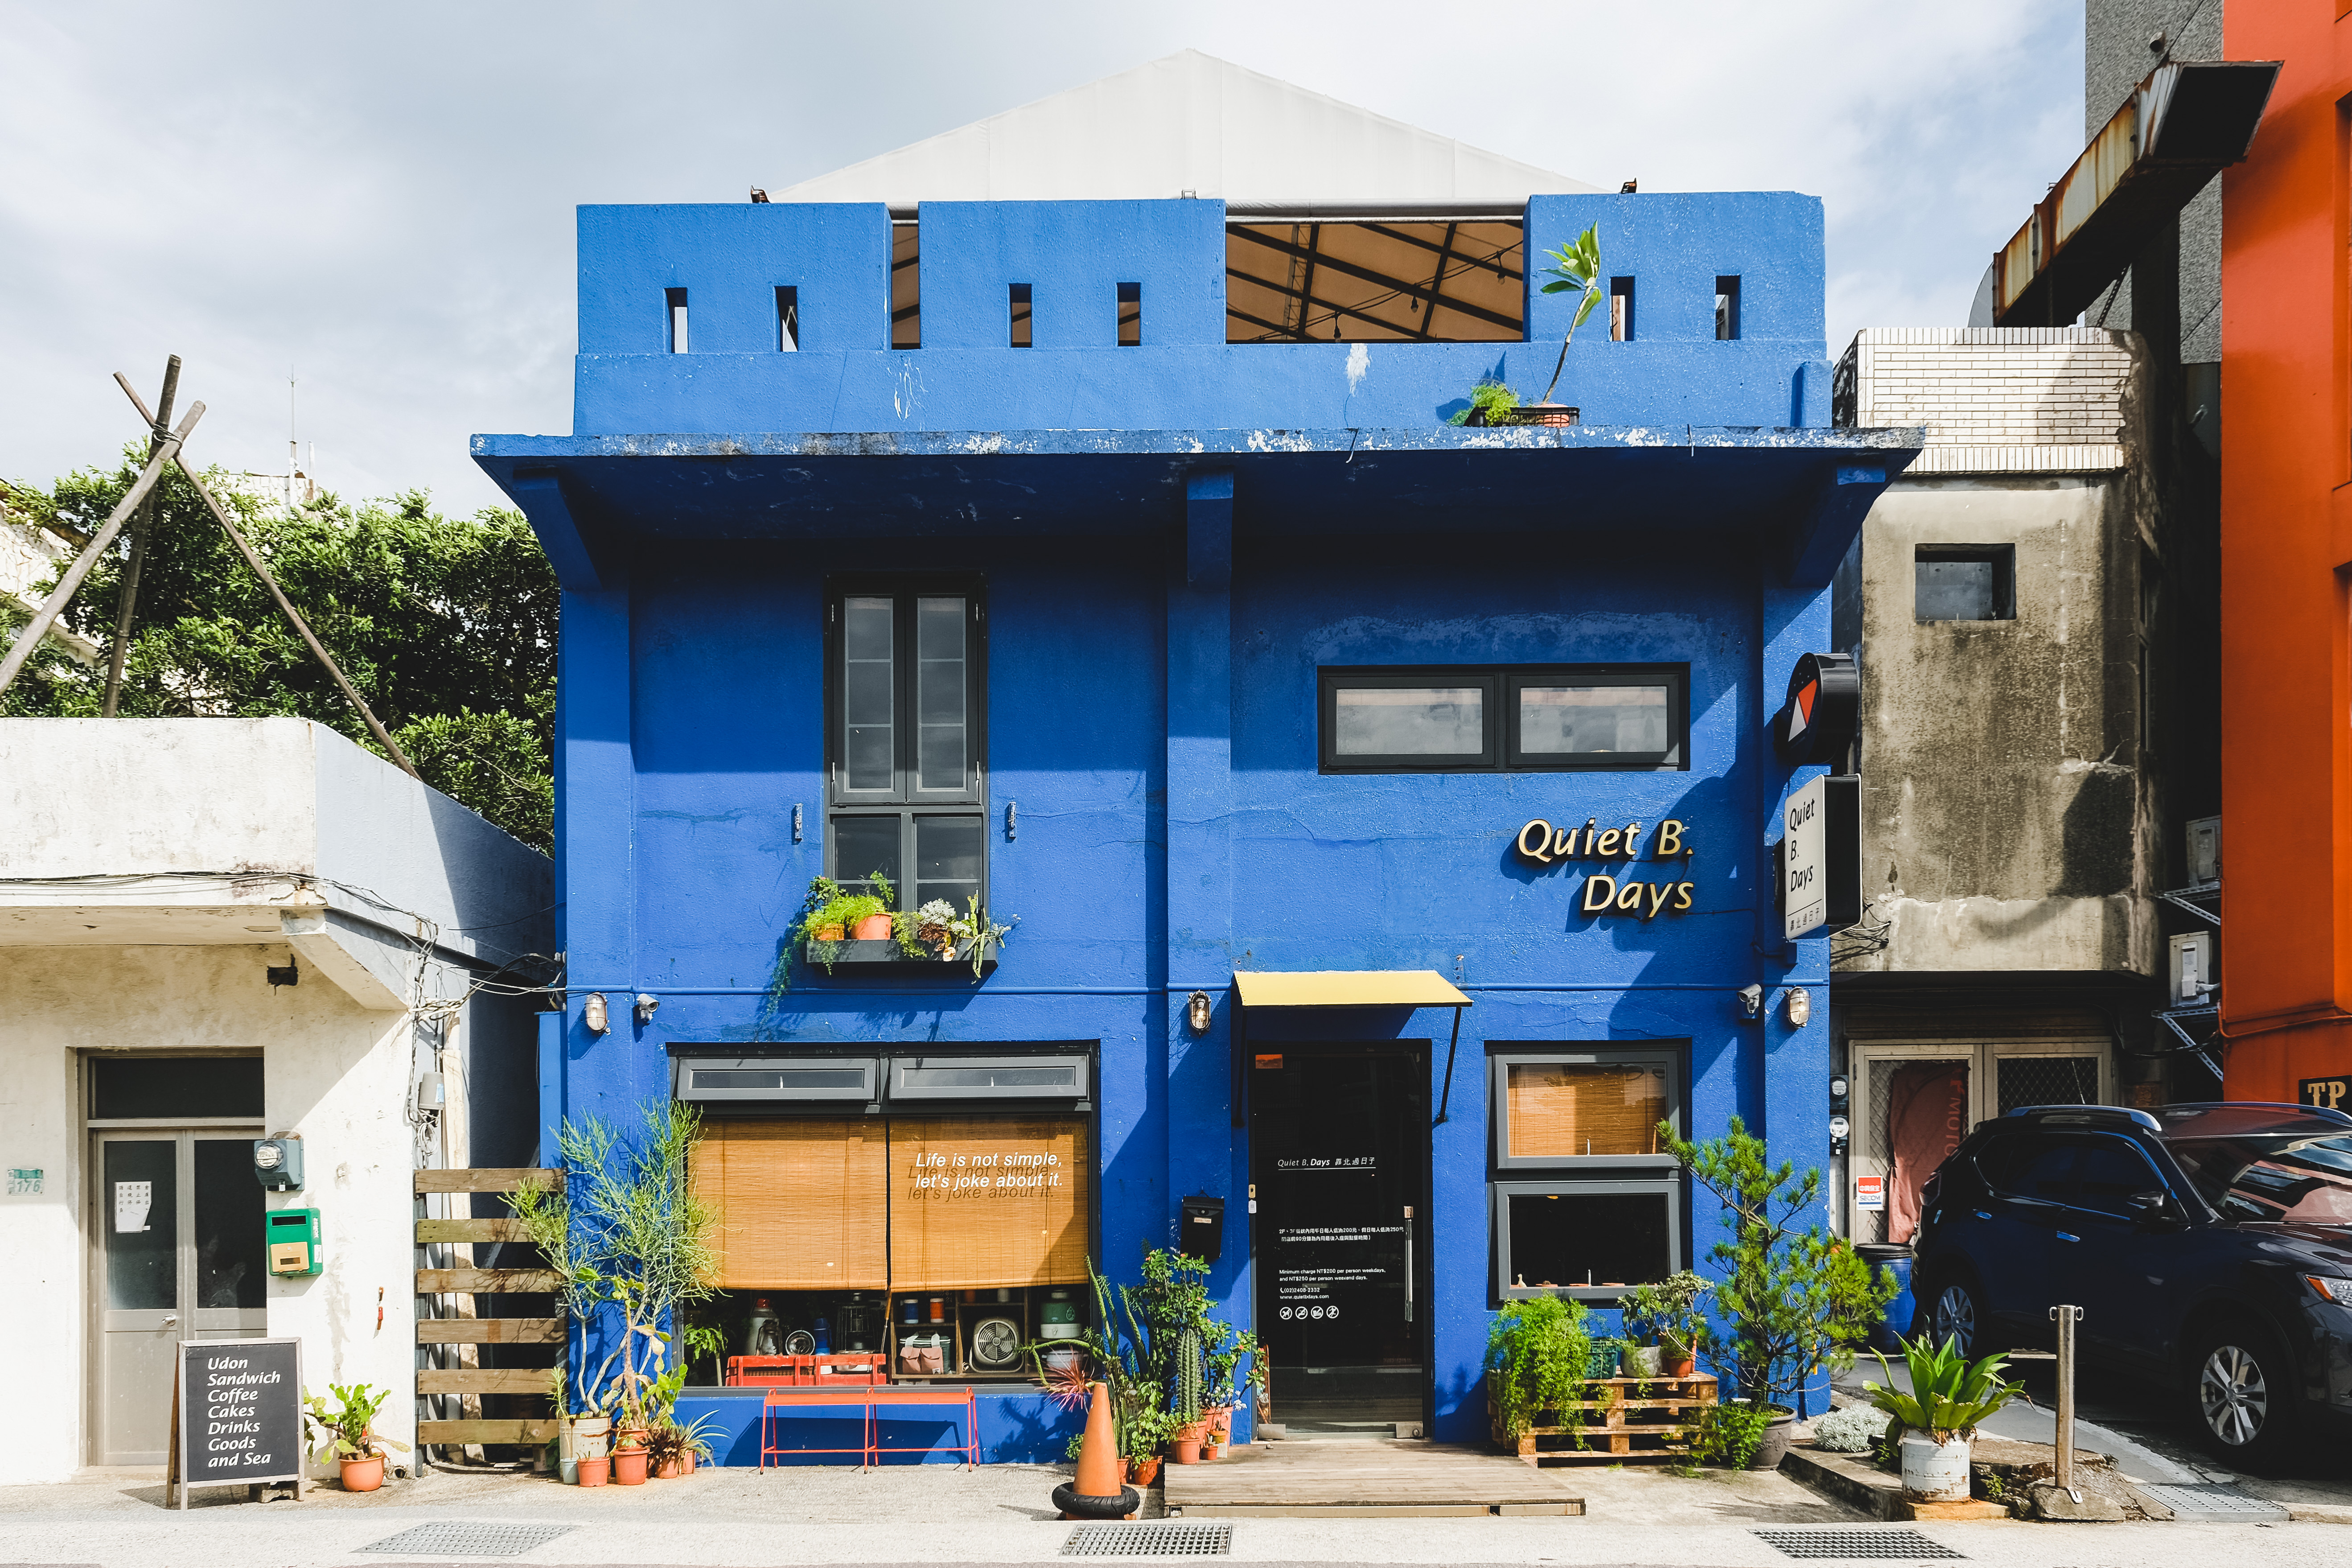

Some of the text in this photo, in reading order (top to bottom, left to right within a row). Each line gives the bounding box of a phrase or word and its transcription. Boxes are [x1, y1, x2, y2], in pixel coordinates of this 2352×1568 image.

[1789, 798, 1815, 832] Quiet
[1518, 818, 1694, 863] Quiet B.
[1790, 840, 1799, 861] B.
[1790, 865, 1813, 892] Days
[1583, 874, 1694, 918] Days
[2307, 1081, 2346, 1108] TP
[916, 1152, 1062, 1169] Life is not simple,
[1278, 1159, 1299, 1168] Quiet
[1310, 1158, 1330, 1167] Days
[17, 1179, 42, 1192] 176
[915, 1173, 1063, 1191] let's joke about it.
[207, 1356, 248, 1370] Udon
[207, 1370, 281, 1386] Sandwich
[208, 1387, 259, 1404] Coffee
[208, 1404, 255, 1419] Cakes
[208, 1420, 260, 1435] Drinks
[208, 1436, 257, 1451] Goods
[208, 1452, 271, 1468] and Sea
